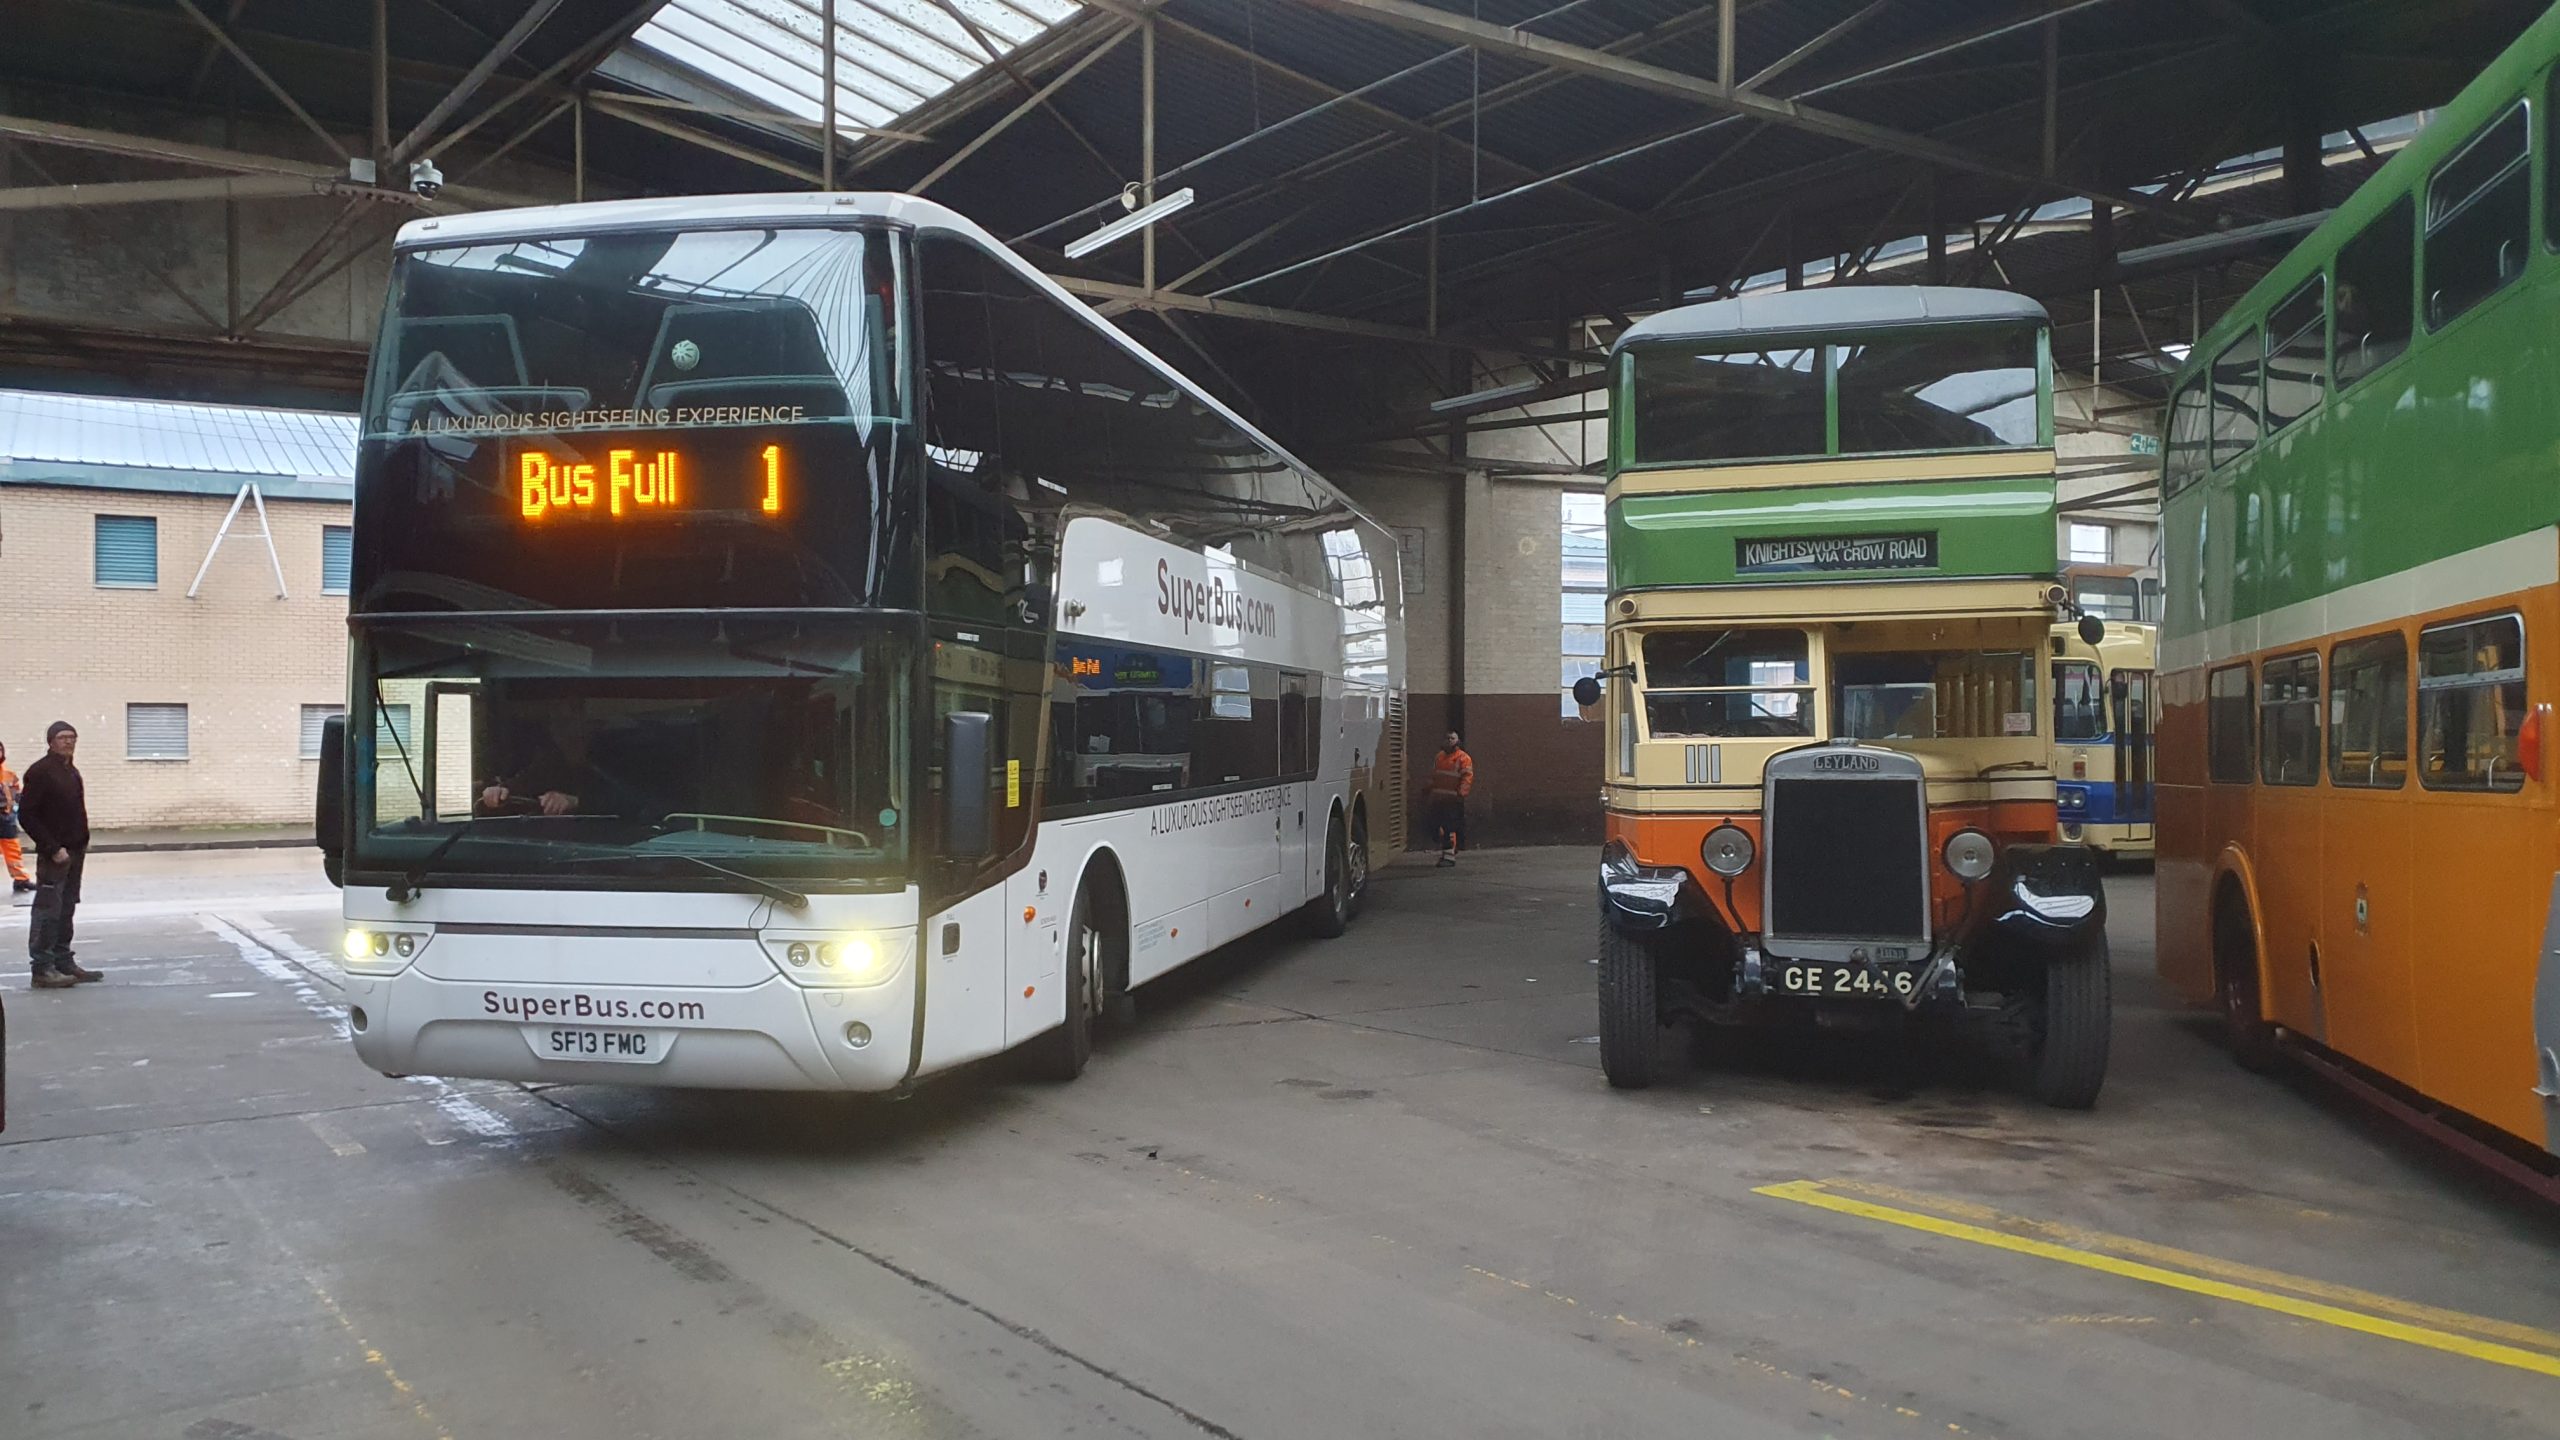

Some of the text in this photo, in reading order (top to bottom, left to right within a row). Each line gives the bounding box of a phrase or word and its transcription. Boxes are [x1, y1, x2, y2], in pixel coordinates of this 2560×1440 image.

[411, 406, 804, 432] A LUXURIOUS SIGHTSEEING EXPERIENCE
[521, 445, 779, 516] Bus Full 1
[1745, 539, 1850, 566] KNIGHTSWOOD
[1816, 537, 1927, 564] VIA CROW ROAD
[1157, 557, 1277, 639] SuperBus.com
[1815, 754, 1879, 770] LEYLAND
[1151, 785, 1292, 837] A LUXURIOUS SIGHTSEEING EXPERIENCE
[1785, 967, 1823, 991] GE
[483, 991, 705, 1021] SuperBus.com
[550, 1031, 598, 1052] SF13
